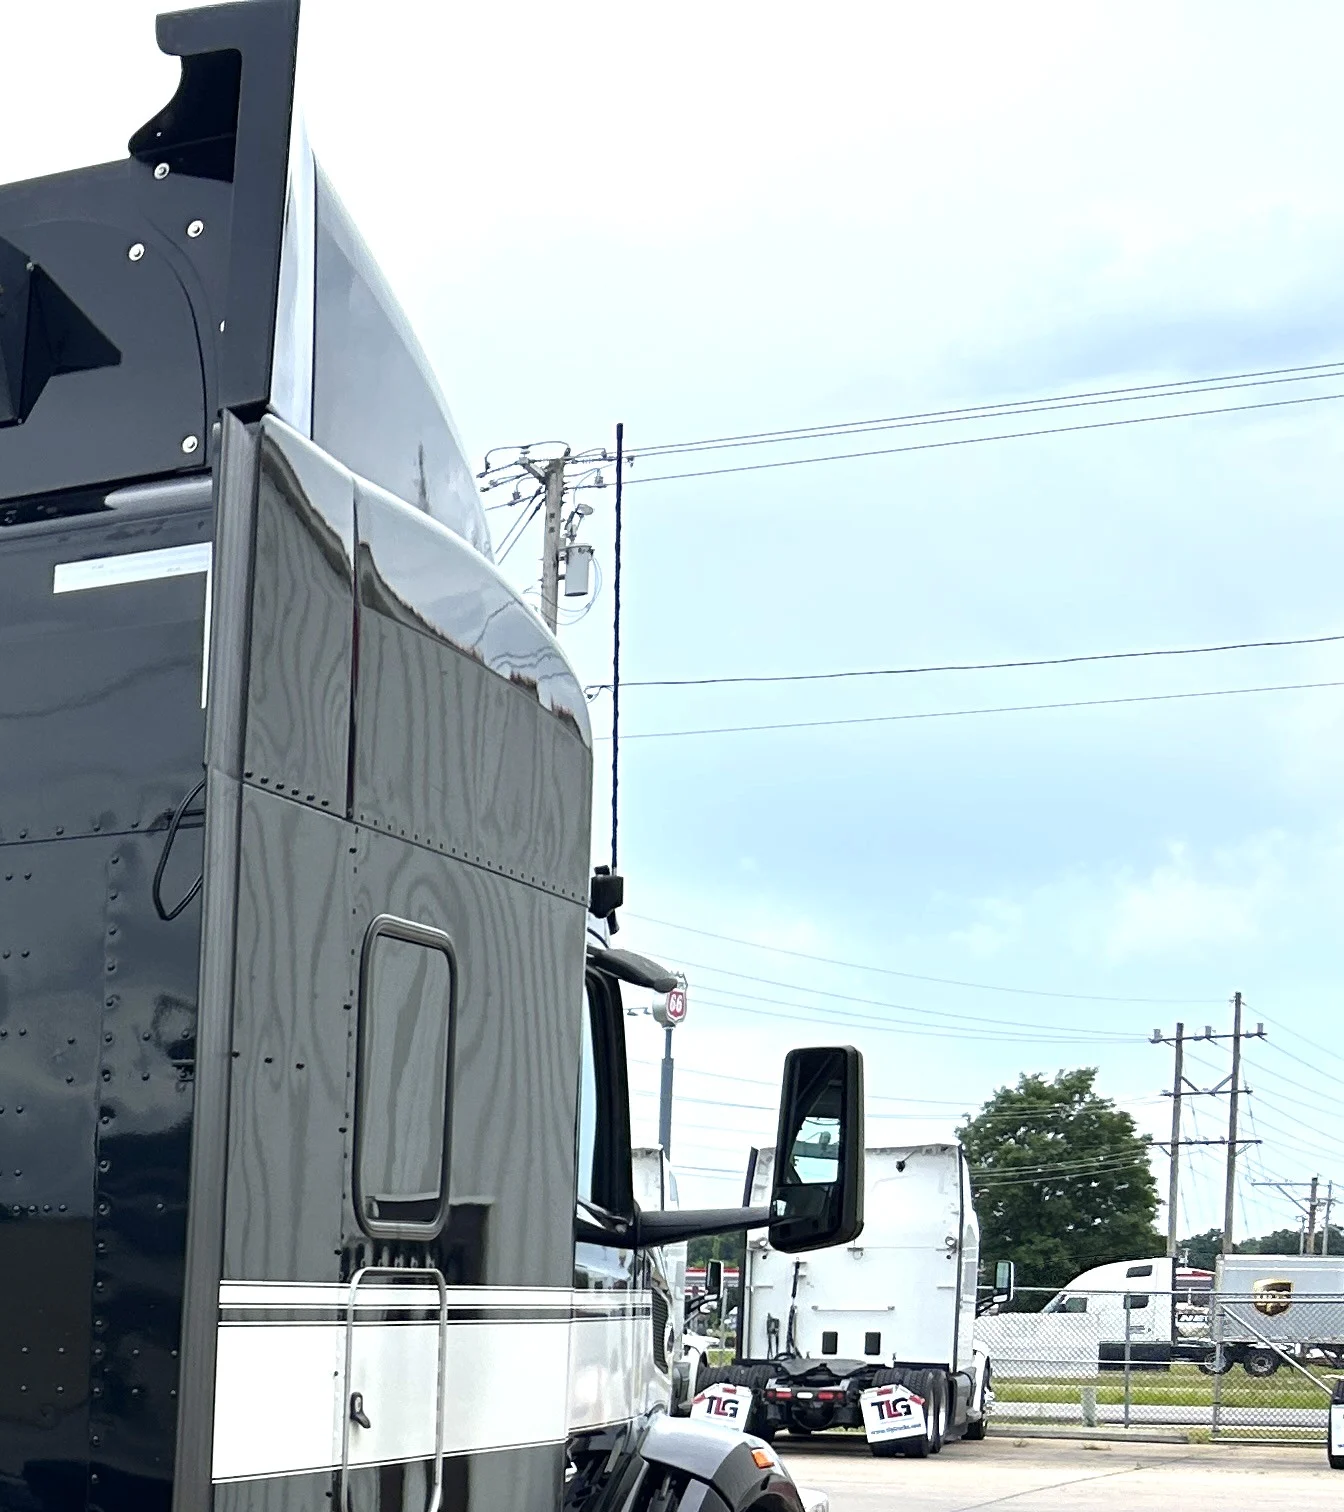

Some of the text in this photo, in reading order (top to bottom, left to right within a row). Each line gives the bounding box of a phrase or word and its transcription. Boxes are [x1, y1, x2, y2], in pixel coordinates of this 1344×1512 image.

[669, 993, 683, 1013] 66
[706, 1395, 739, 1418] TLG
[871, 1397, 912, 1420] TLG
